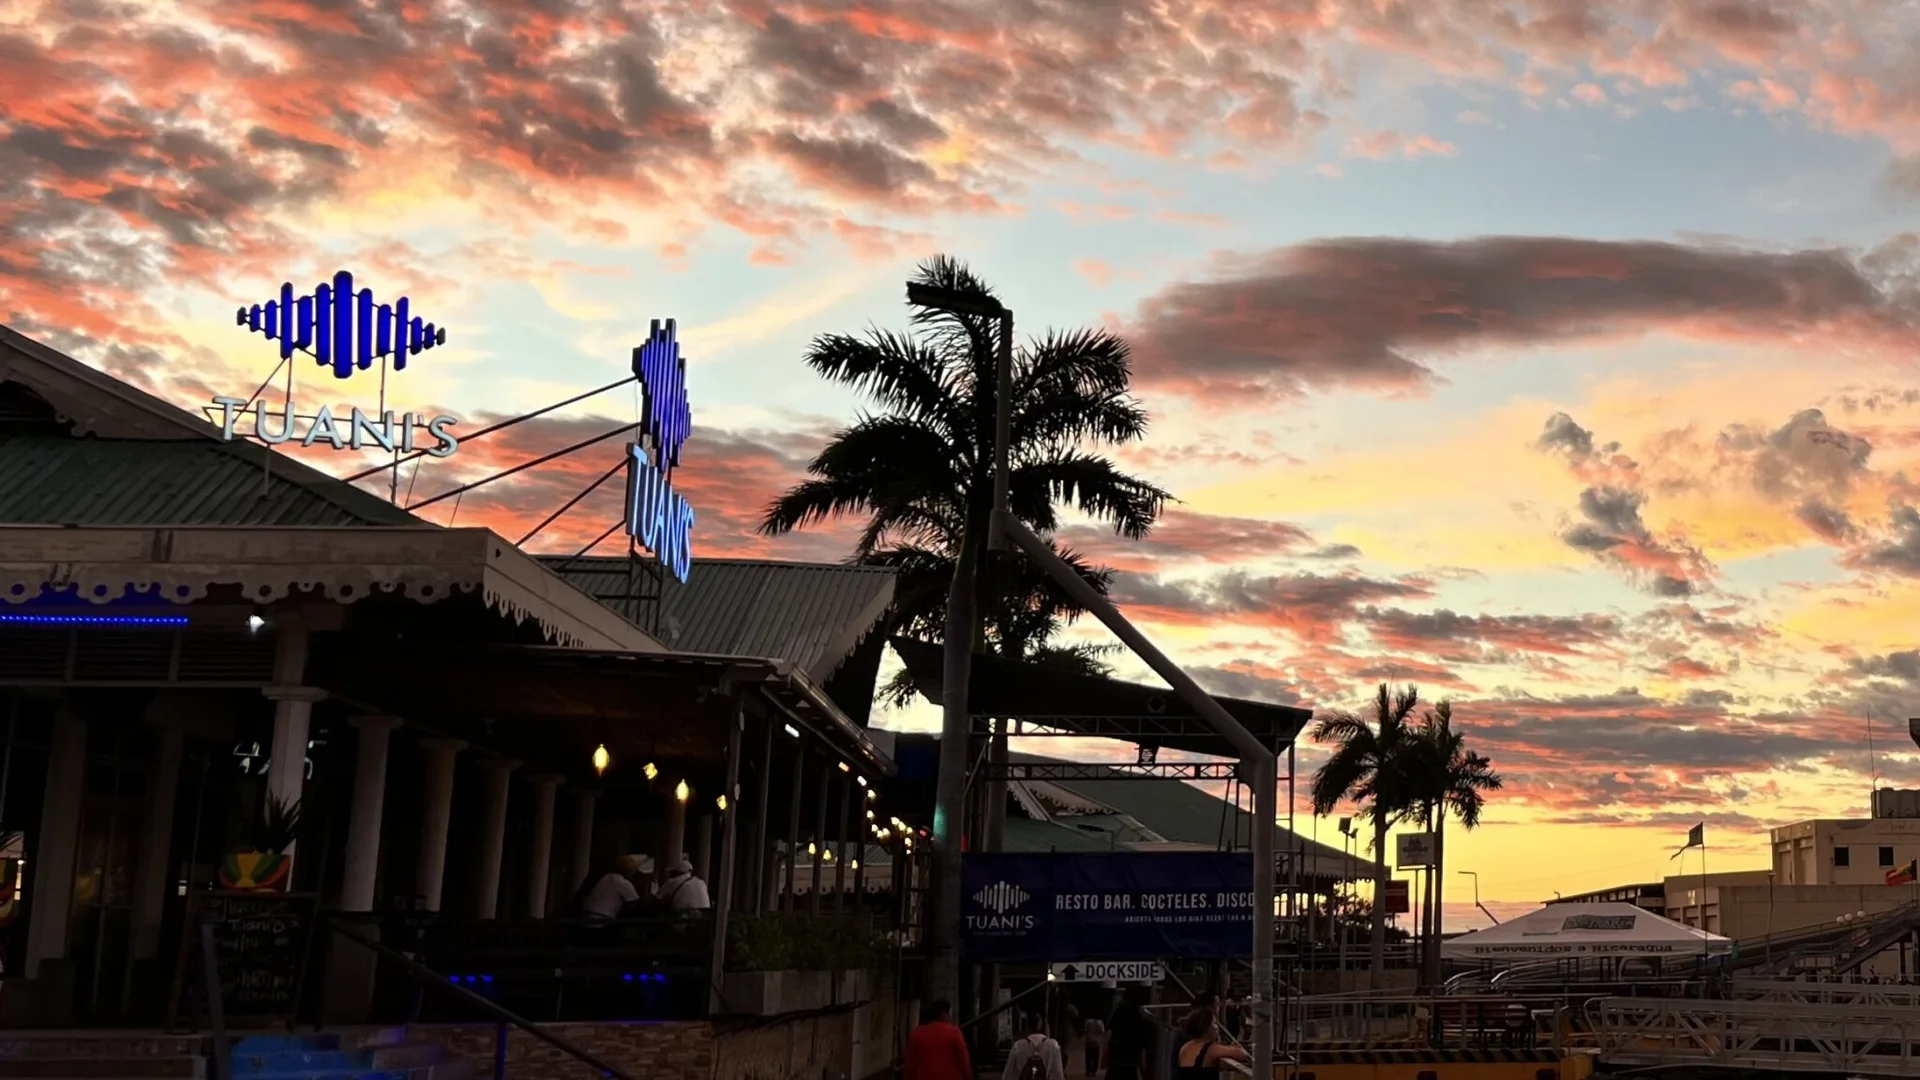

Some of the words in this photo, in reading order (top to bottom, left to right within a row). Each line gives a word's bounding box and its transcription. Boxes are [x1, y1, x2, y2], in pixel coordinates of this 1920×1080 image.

[212, 396, 458, 458] TUANI'S
[1055, 893, 1099, 911] RESTO
[1103, 893, 1135, 910] BAR.
[1140, 892, 1212, 910] COCTELES.
[965, 914, 1034, 930] TUANI'S
[1592, 944, 1673, 953] Nicaragua
[1086, 963, 1159, 979] DOCKSIDE
